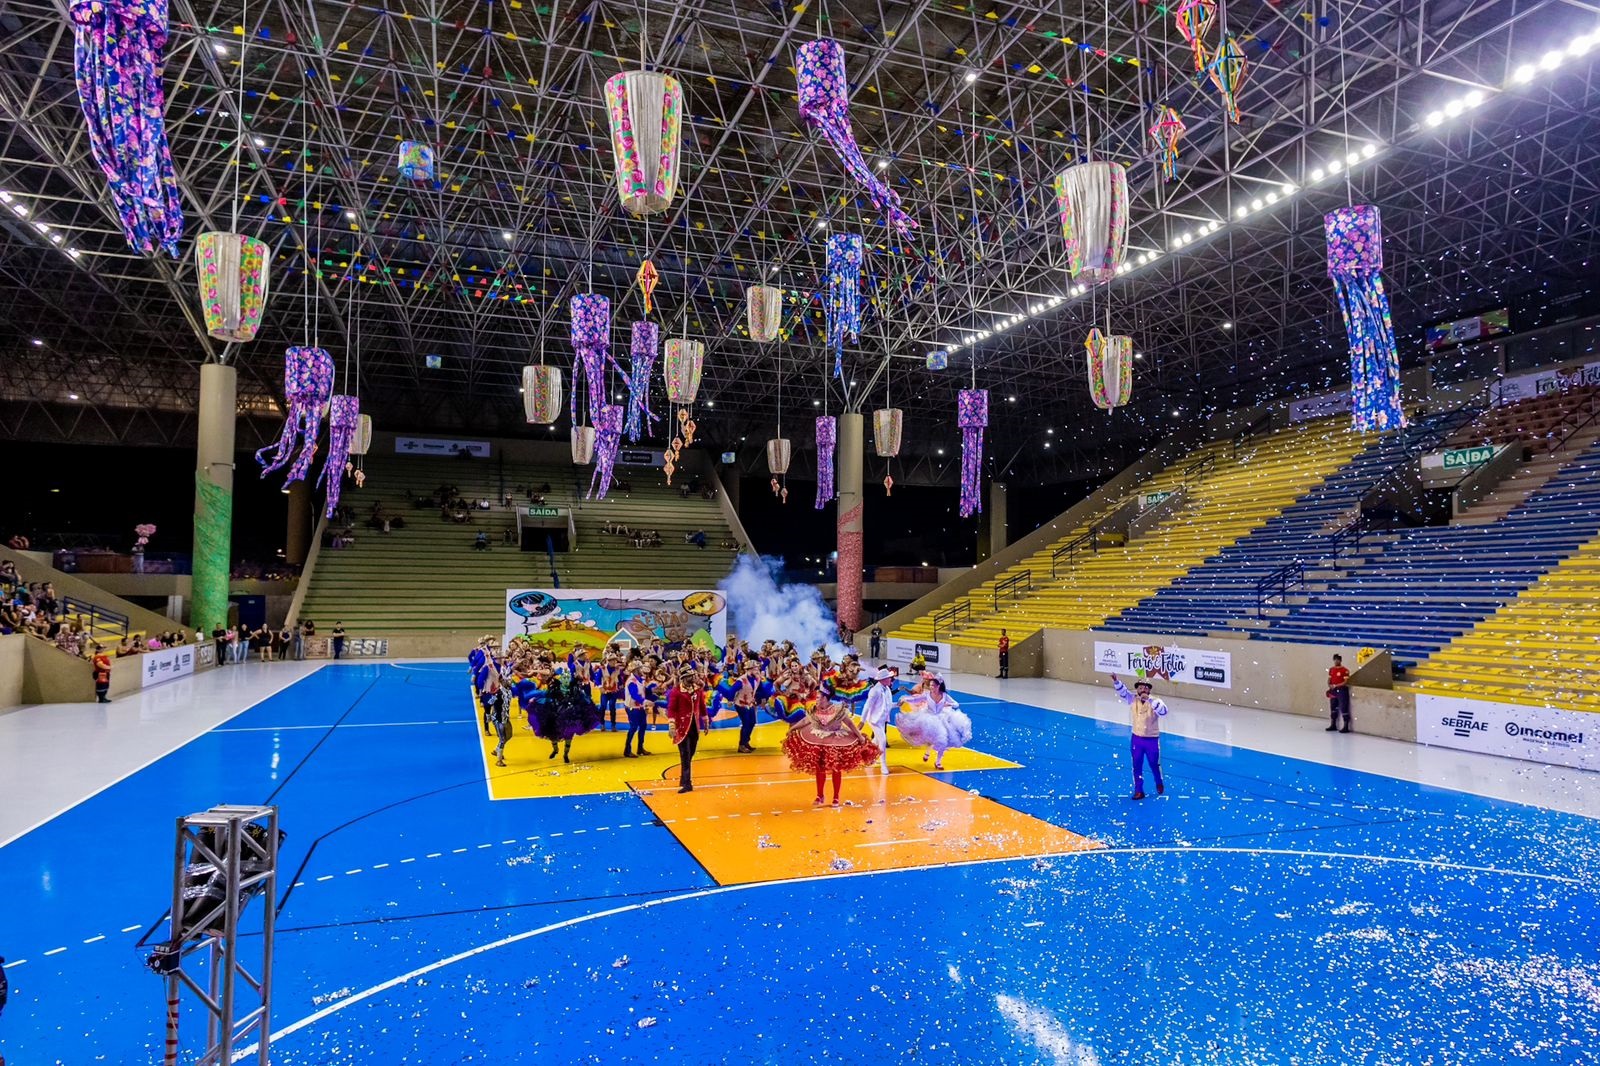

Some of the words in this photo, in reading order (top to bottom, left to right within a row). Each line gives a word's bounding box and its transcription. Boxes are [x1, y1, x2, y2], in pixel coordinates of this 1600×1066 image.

[1446, 450, 1491, 464] SAÍDA
[530, 507, 557, 516] SAÍDA
[341, 639, 383, 656] SESI
[1128, 652, 1153, 670] Forró
[1161, 653, 1185, 672] Folia
[1441, 717, 1489, 732] SEBRAE
